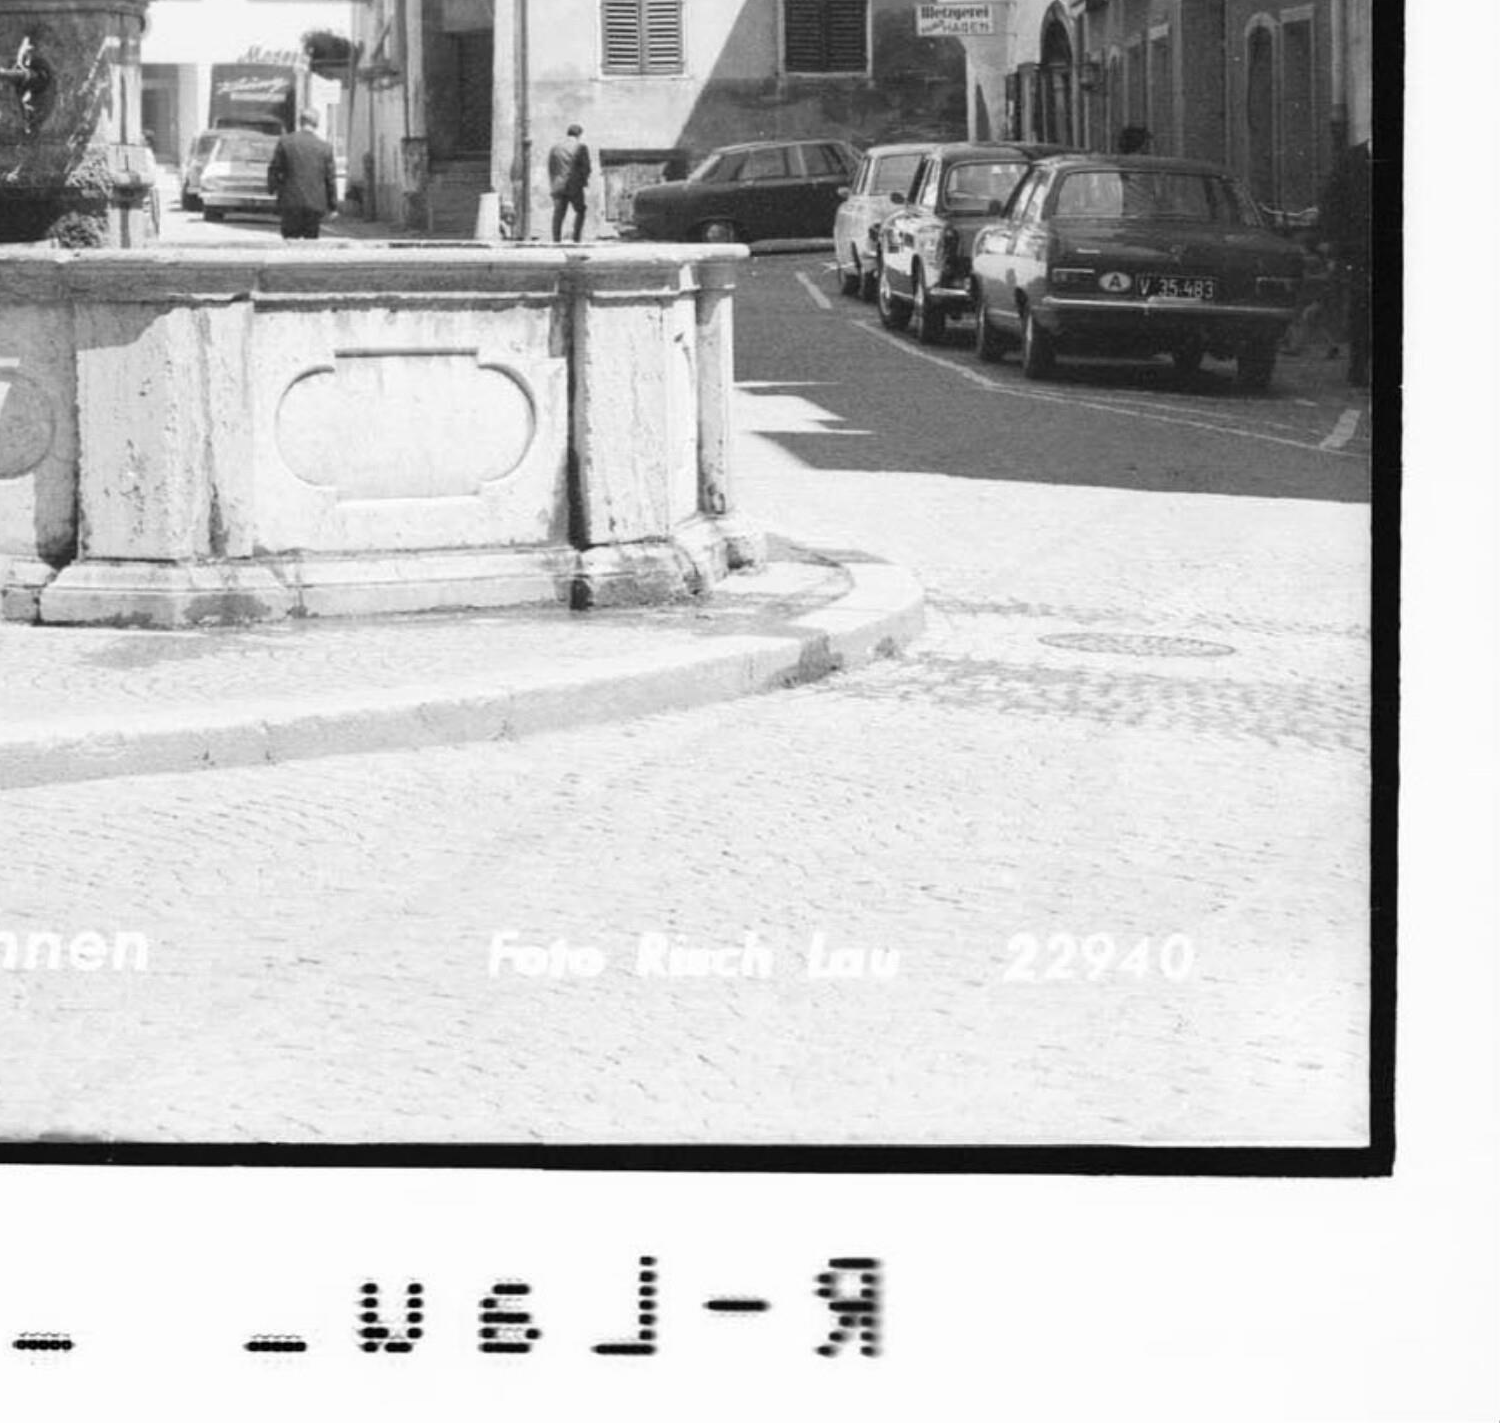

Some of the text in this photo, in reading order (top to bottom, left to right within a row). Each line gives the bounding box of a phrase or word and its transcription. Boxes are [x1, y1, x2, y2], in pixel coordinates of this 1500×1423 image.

[921, 4, 989, 21] Metzgerei
[1107, 274, 1123, 290] A
[1139, 278, 1151, 296] V
